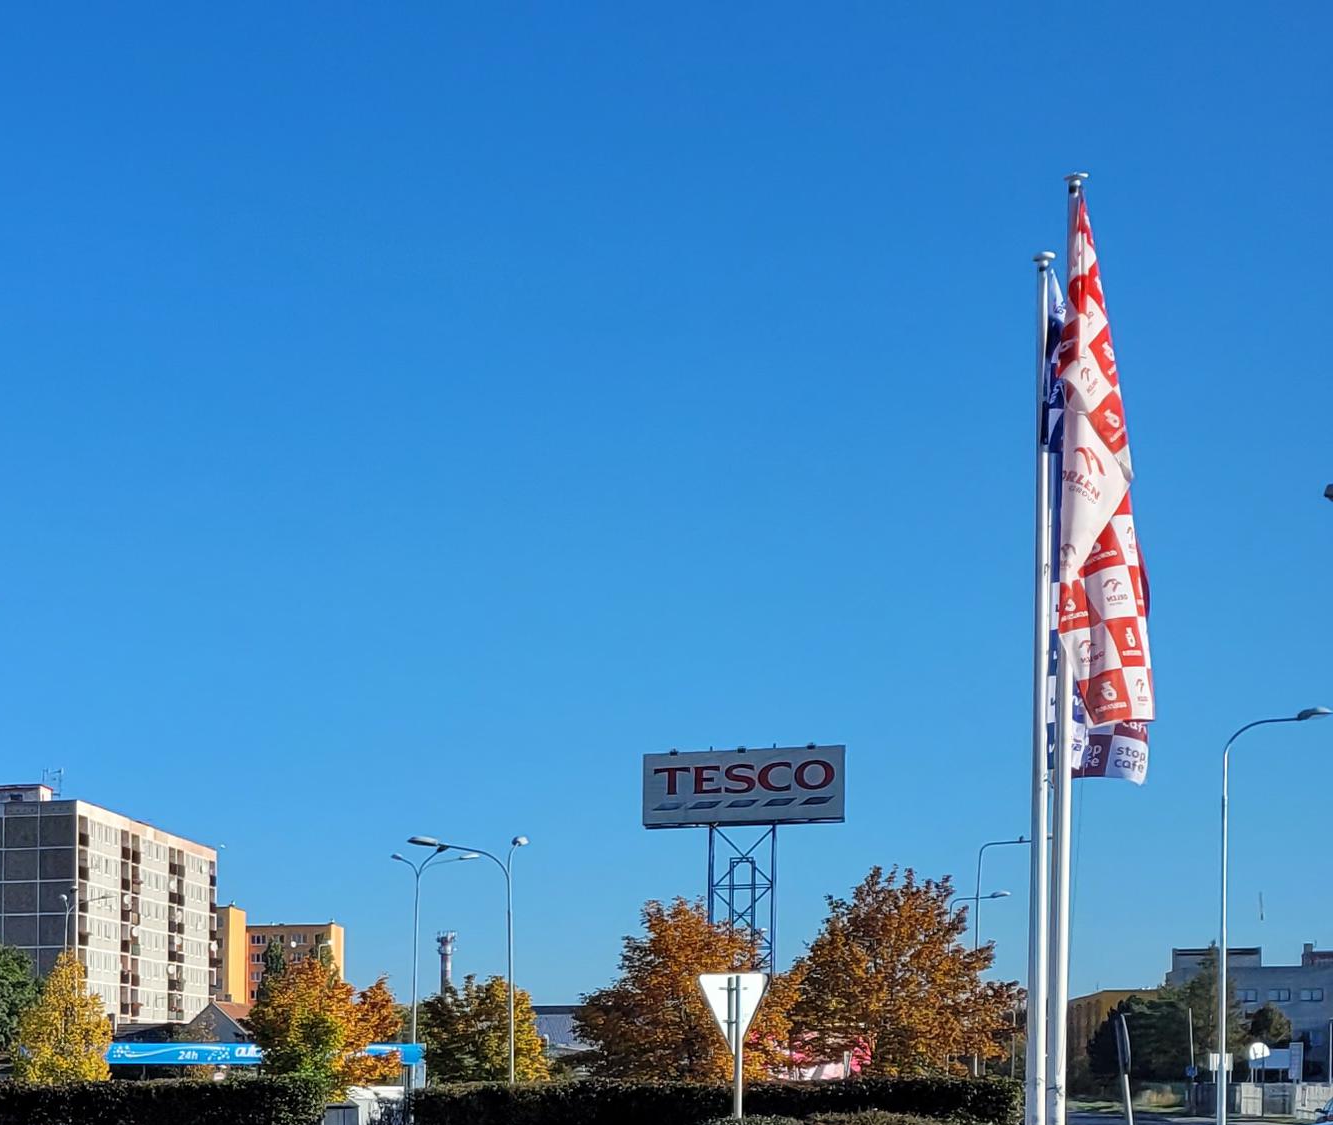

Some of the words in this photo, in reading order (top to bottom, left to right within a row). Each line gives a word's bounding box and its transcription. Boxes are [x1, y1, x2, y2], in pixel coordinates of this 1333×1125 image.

[1116, 746, 1146, 763] stop
[1114, 759, 1145, 773] cafe
[653, 760, 835, 795] TESCO
[178, 1050, 198, 1060] 24h
